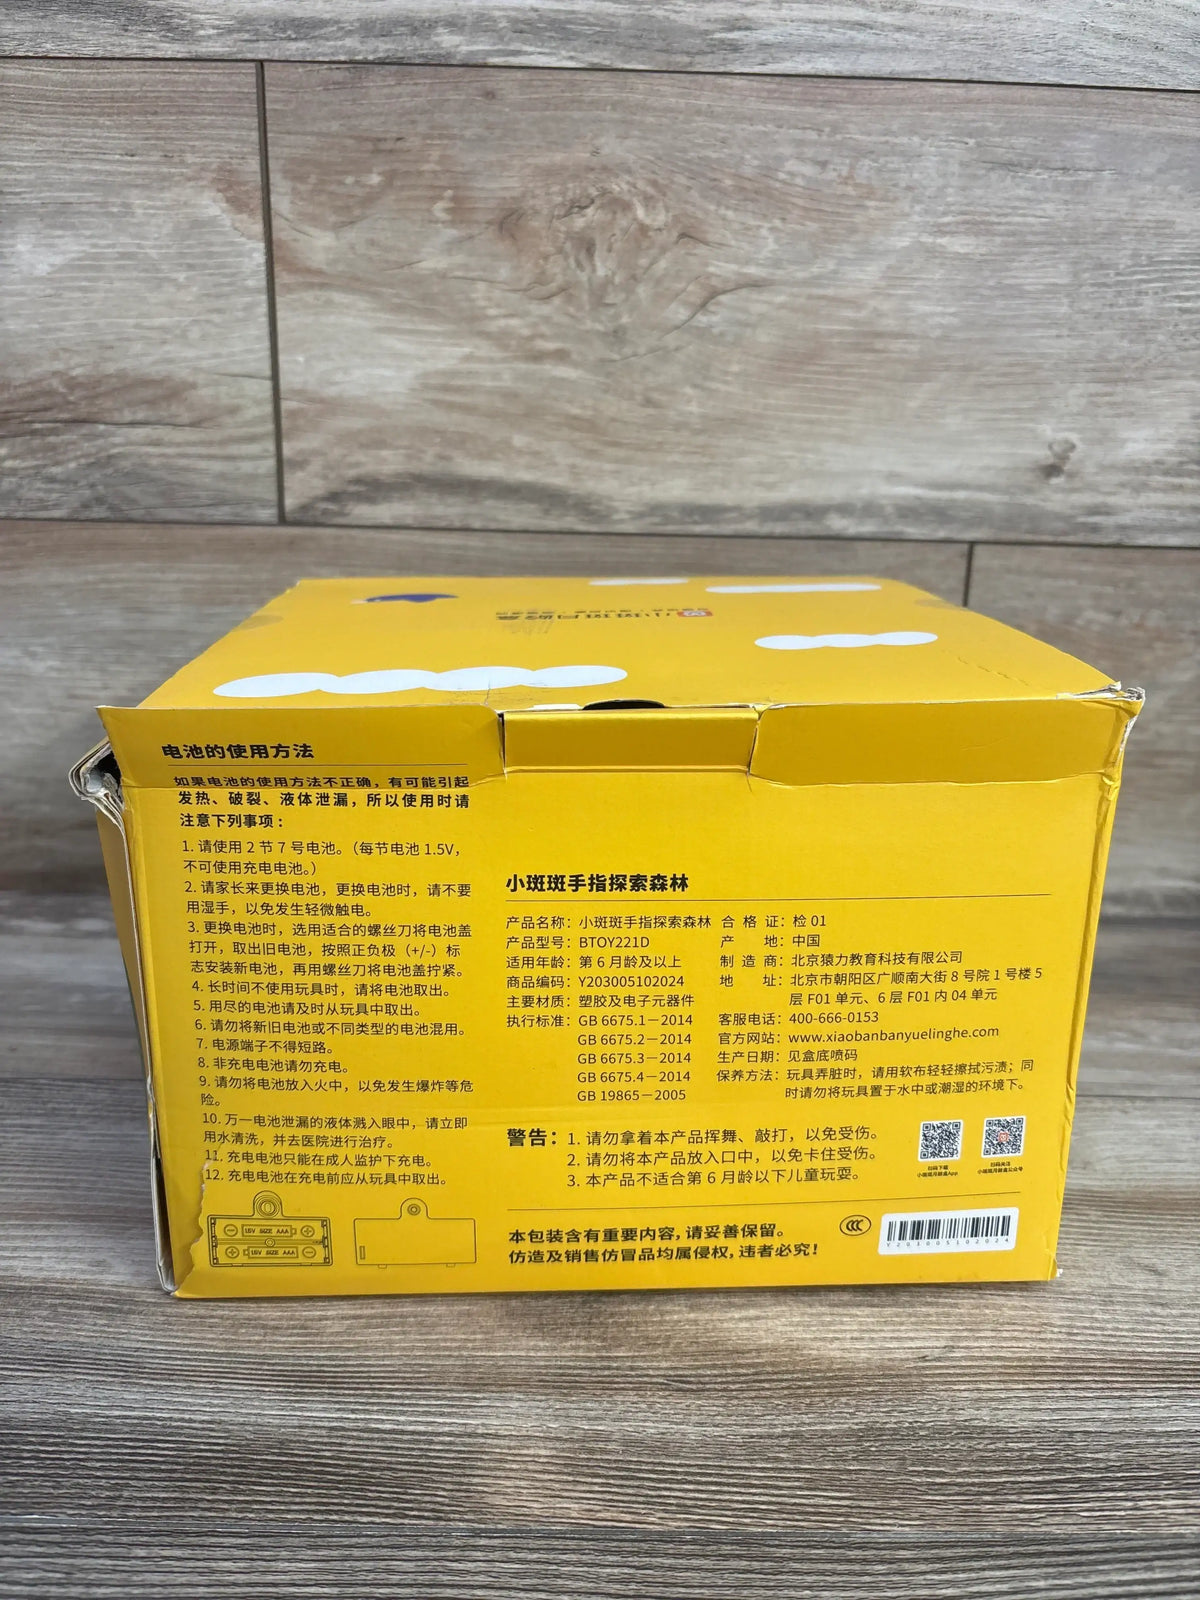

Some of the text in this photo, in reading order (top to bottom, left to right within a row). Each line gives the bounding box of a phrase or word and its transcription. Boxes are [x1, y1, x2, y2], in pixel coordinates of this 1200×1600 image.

[163, 743, 314, 759] 电池的使用方法
[173, 776, 469, 789] 如果电池的使用方法不正确，有可能引起
[178, 791, 469, 808] 发热、破裂、液体泄漏，所以使用时请
[180, 813, 282, 830] 注意下列事项：
[183, 840, 459, 856] 1. 请使用 2 节 7 号电池。（每节电池 1.5V，
[184, 859, 316, 878] 不可使用充电电池。）
[185, 880, 471, 897] 2. 请家长来更换电池，更换电池时，请不要
[506, 873, 688, 892] 小斑斑手指探索森林
[187, 901, 371, 920] 用湿手，以免发生轻微触电。
[188, 920, 472, 937] 3. 更换电池时，选用适合的螺丝刀将电池盖
[811, 915, 826, 926] 01
[189, 940, 460, 959] 打开，取出旧电池，按照正负极（+/-）标
[191, 960, 462, 977] 志安装新电池，再用螺丝刀将电池盖拧紧。
[597, 956, 605, 968] 6
[609, 955, 681, 968] 月龄及以上
[951, 971, 958, 982] 8
[963, 969, 990, 982] 号院
[994, 970, 1000, 980] 1
[1005, 967, 1031, 980] 号楼
[1035, 968, 1042, 978] 5
[192, 980, 448, 997] 4. 长时间不使用玩具时，请将电池取出。
[789, 993, 803, 1006] 层
[808, 993, 830, 1004] F01
[889, 991, 902, 1003] 层
[908, 991, 929, 1002] F01
[935, 989, 947, 1002] 内
[952, 990, 967, 1001] 04
[970, 988, 997, 1000] 单元
[194, 1000, 419, 1016] 5. 用尽的电池请及时从玩具中取出。
[195, 1019, 464, 1035] 6. 请勿将新旧电池或不同类型的电池混用。
[196, 1038, 332, 1055] 7. 电源端子不得短路。
[578, 1034, 597, 1045] GB
[198, 1057, 347, 1073] 8. 非充电电池请勿充电。
[578, 1052, 596, 1064] GB
[199, 1076, 473, 1092] 9. 请勿将电池放入火中，以免发生爆炸等危
[577, 1072, 596, 1083] GB
[577, 1091, 596, 1101] GB
[785, 1078, 1023, 1099] 时请勿将玩具置于水中或潮湿的环境下。
[201, 1093, 220, 1106] 险。
[203, 1113, 467, 1130] 10. 万一电池泄漏的液体溅入眼中，请立即
[204, 1131, 392, 1149] 用水清洗，并去医院进行治疗。
[507, 1128, 556, 1147] 警告：
[568, 1125, 876, 1146] 1. 请勿拿着本产品挥舞、敲打，以免受伤。
[206, 1149, 431, 1167] 11. 充电电池只能在成人监护下充电。
[567, 1146, 875, 1167] 2. 请勿将本产品放入口中，以免卡住受伤。
[206, 1169, 446, 1185] 12. 充电电池在充电前应从玩具中取出。
[567, 1166, 858, 1188] 3. 本产品不适合第 6 月龄以下儿童玩耍。
[509, 1223, 783, 1244] 本包装含有重要内容，请妥善保留。
[509, 1243, 817, 1264] 仿造及销售仿冒品均属侵权，违者必究！
